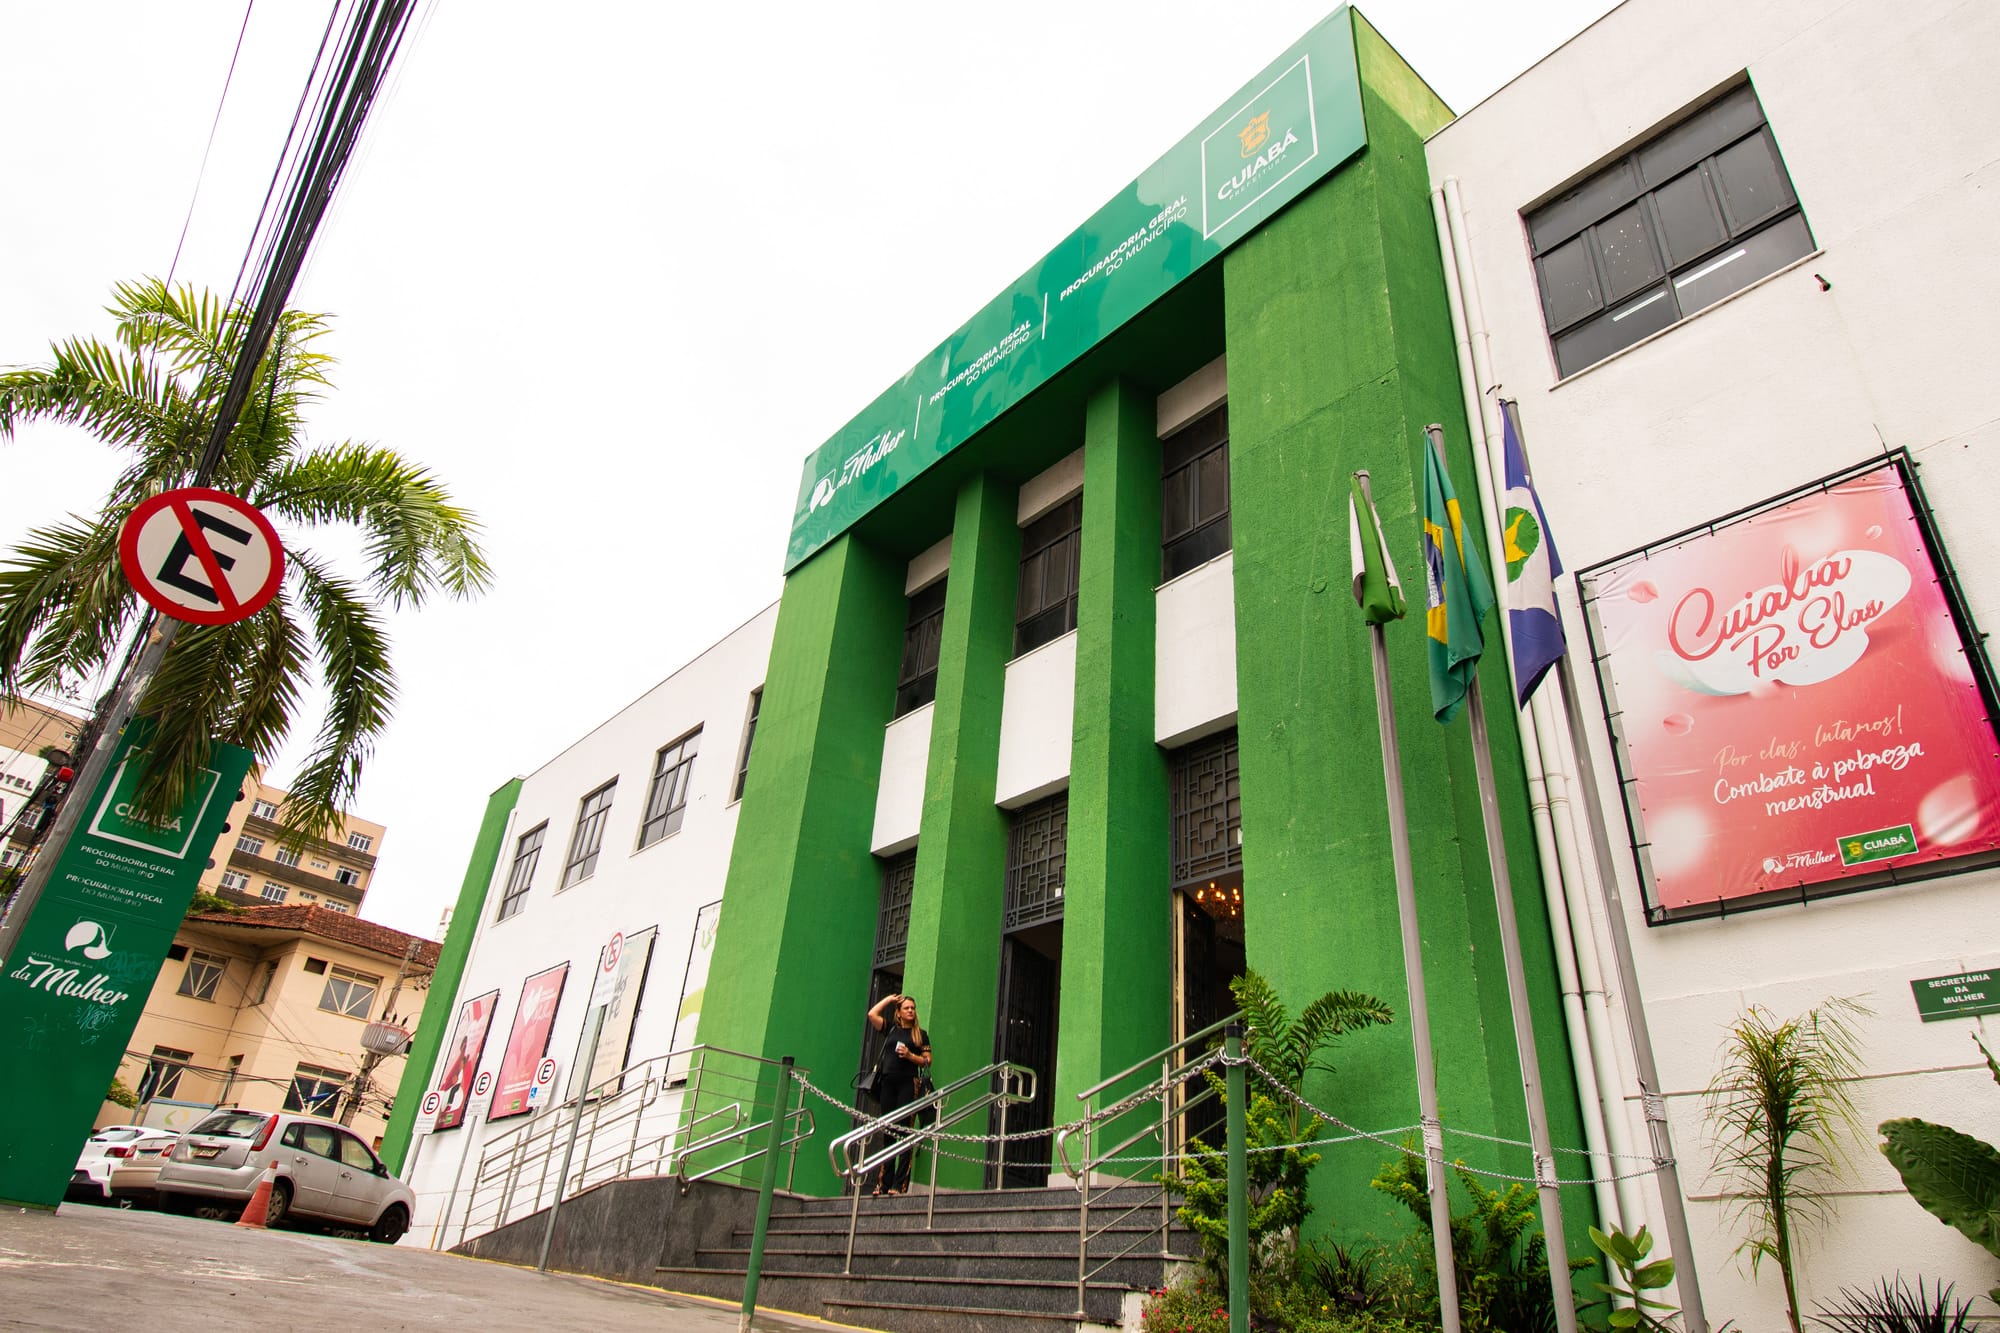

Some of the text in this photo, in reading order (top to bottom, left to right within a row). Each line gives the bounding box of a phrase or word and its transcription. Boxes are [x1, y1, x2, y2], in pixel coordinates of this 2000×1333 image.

[1217, 127, 1299, 200] CUIABÁ
[1060, 195, 1187, 301] PROCURADORIA GERAL
[1106, 207, 1187, 276] DO MUNICÍPIO
[929, 320, 1031, 405] PROCURADORIA FISCAL
[966, 331, 1030, 386] DO MUNICÍPIO
[843, 429, 906, 485] Mulher
[156, 508, 253, 605] E
[1730, 590, 1884, 678] Por Elas
[1713, 744, 1752, 775] Por
[1814, 703, 1903, 748] lutamos!
[1714, 742, 1925, 804] Combate à pobreza
[1766, 774, 1876, 816] menstrual
[80, 845, 175, 876] PROCURADORIA GERAL
[95, 858, 110, 867] DO
[1786, 850, 1836, 868] Mulher
[1863, 833, 1907, 850] CUIABÁ
[136, 891, 164, 904] FISCAL
[10, 964, 31, 981] da
[27, 955, 129, 1006] Mulher
[1942, 992, 1986, 1004] MULHER
[1953, 985, 1969, 994] DA
[478, 1076, 488, 1092] E
[541, 1063, 552, 1080] E
[426, 1096, 436, 1111] E
